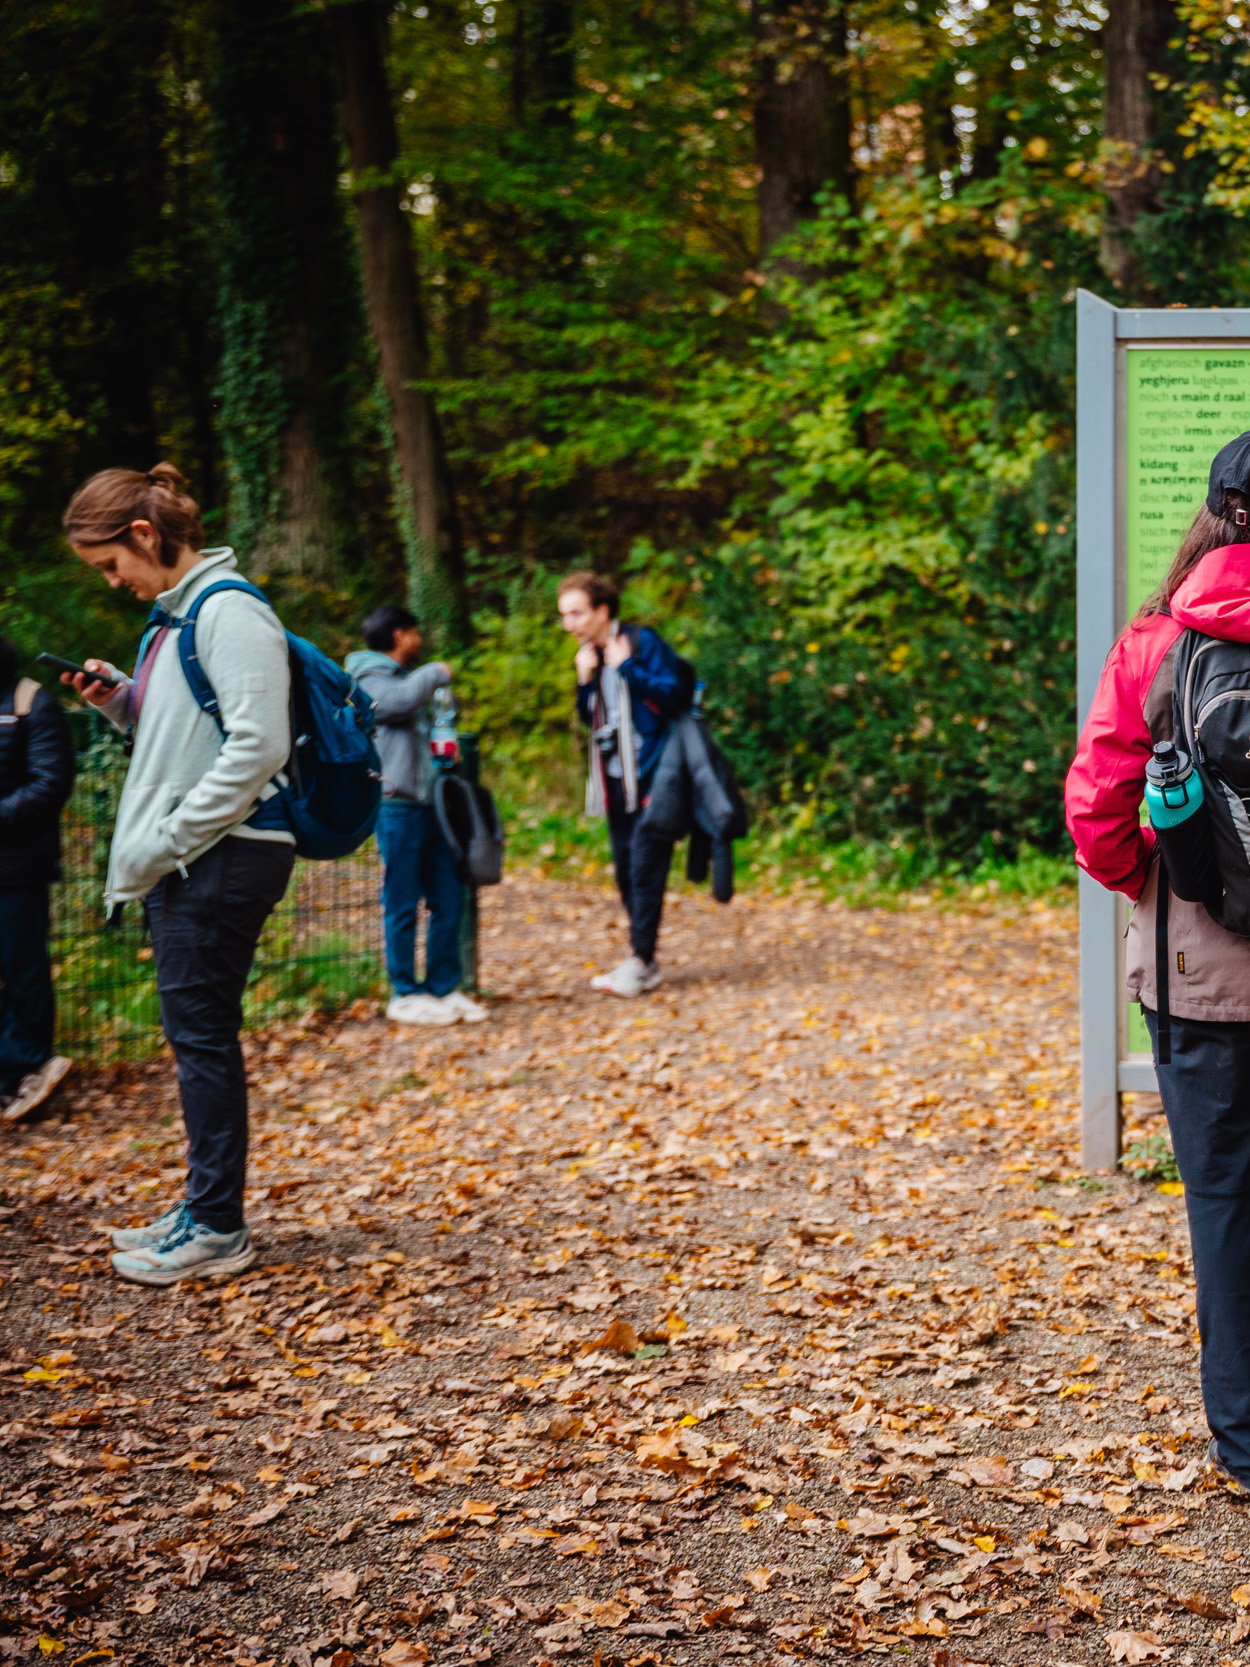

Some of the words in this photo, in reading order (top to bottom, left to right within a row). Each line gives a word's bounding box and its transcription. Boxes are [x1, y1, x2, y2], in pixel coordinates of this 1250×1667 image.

[1204, 359, 1246, 371] gavazn
[1139, 374, 1190, 388] yeghjeru
[1181, 390, 1210, 402] main
[1213, 390, 1221, 402] d
[1223, 390, 1246, 402] raal
[1196, 407, 1222, 419] deer
[1184, 424, 1213, 436] irmis
[1169, 443, 1195, 452] rusa
[1139, 457, 1179, 472] kidang
[1139, 510, 1164, 519] rusa
